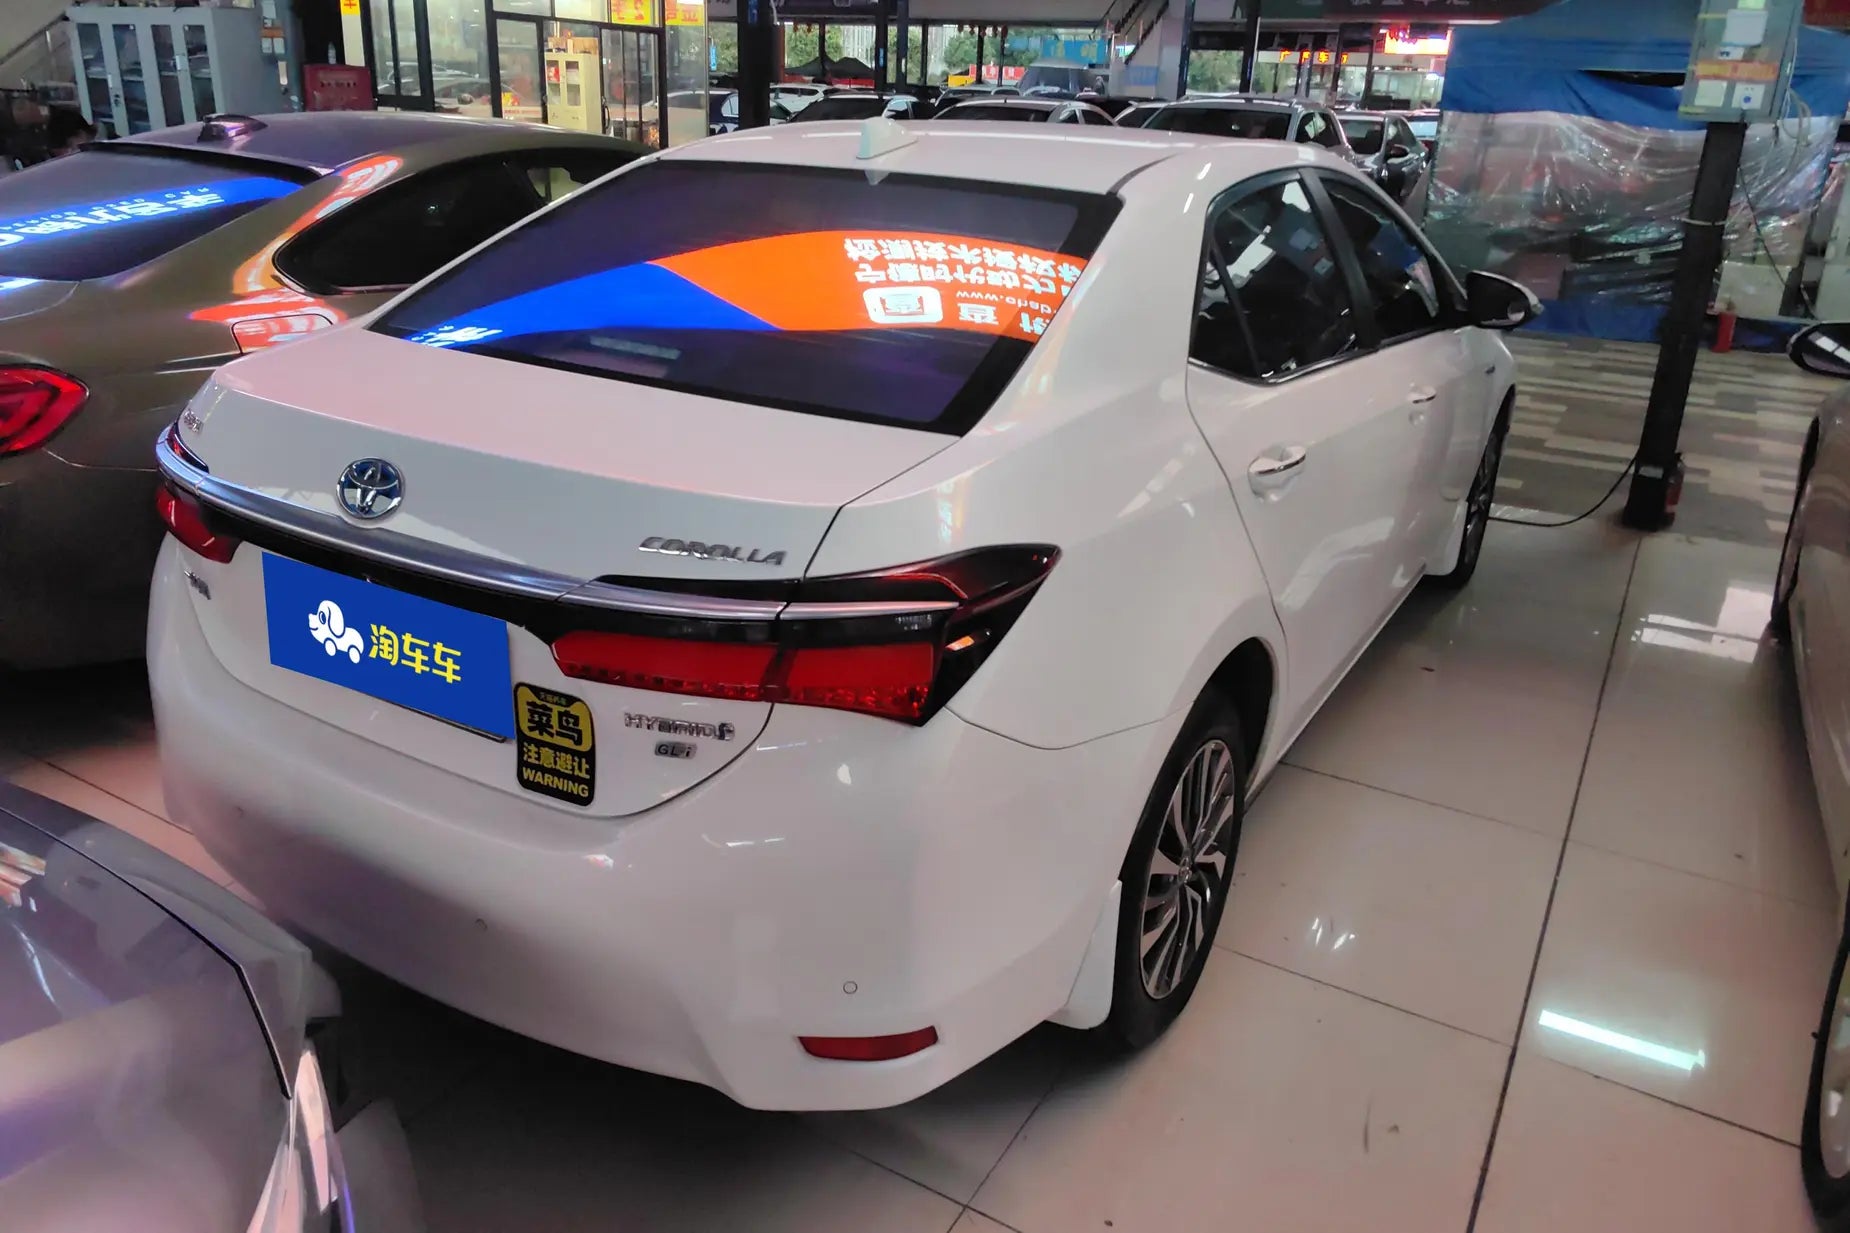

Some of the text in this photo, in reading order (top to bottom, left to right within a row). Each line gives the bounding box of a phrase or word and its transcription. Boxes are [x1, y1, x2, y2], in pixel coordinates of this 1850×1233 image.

[638, 536, 787, 566] COROLLA
[526, 700, 583, 746] 菜鸟
[522, 742, 591, 780] 注意避让
[522, 766, 590, 798] WARNING
